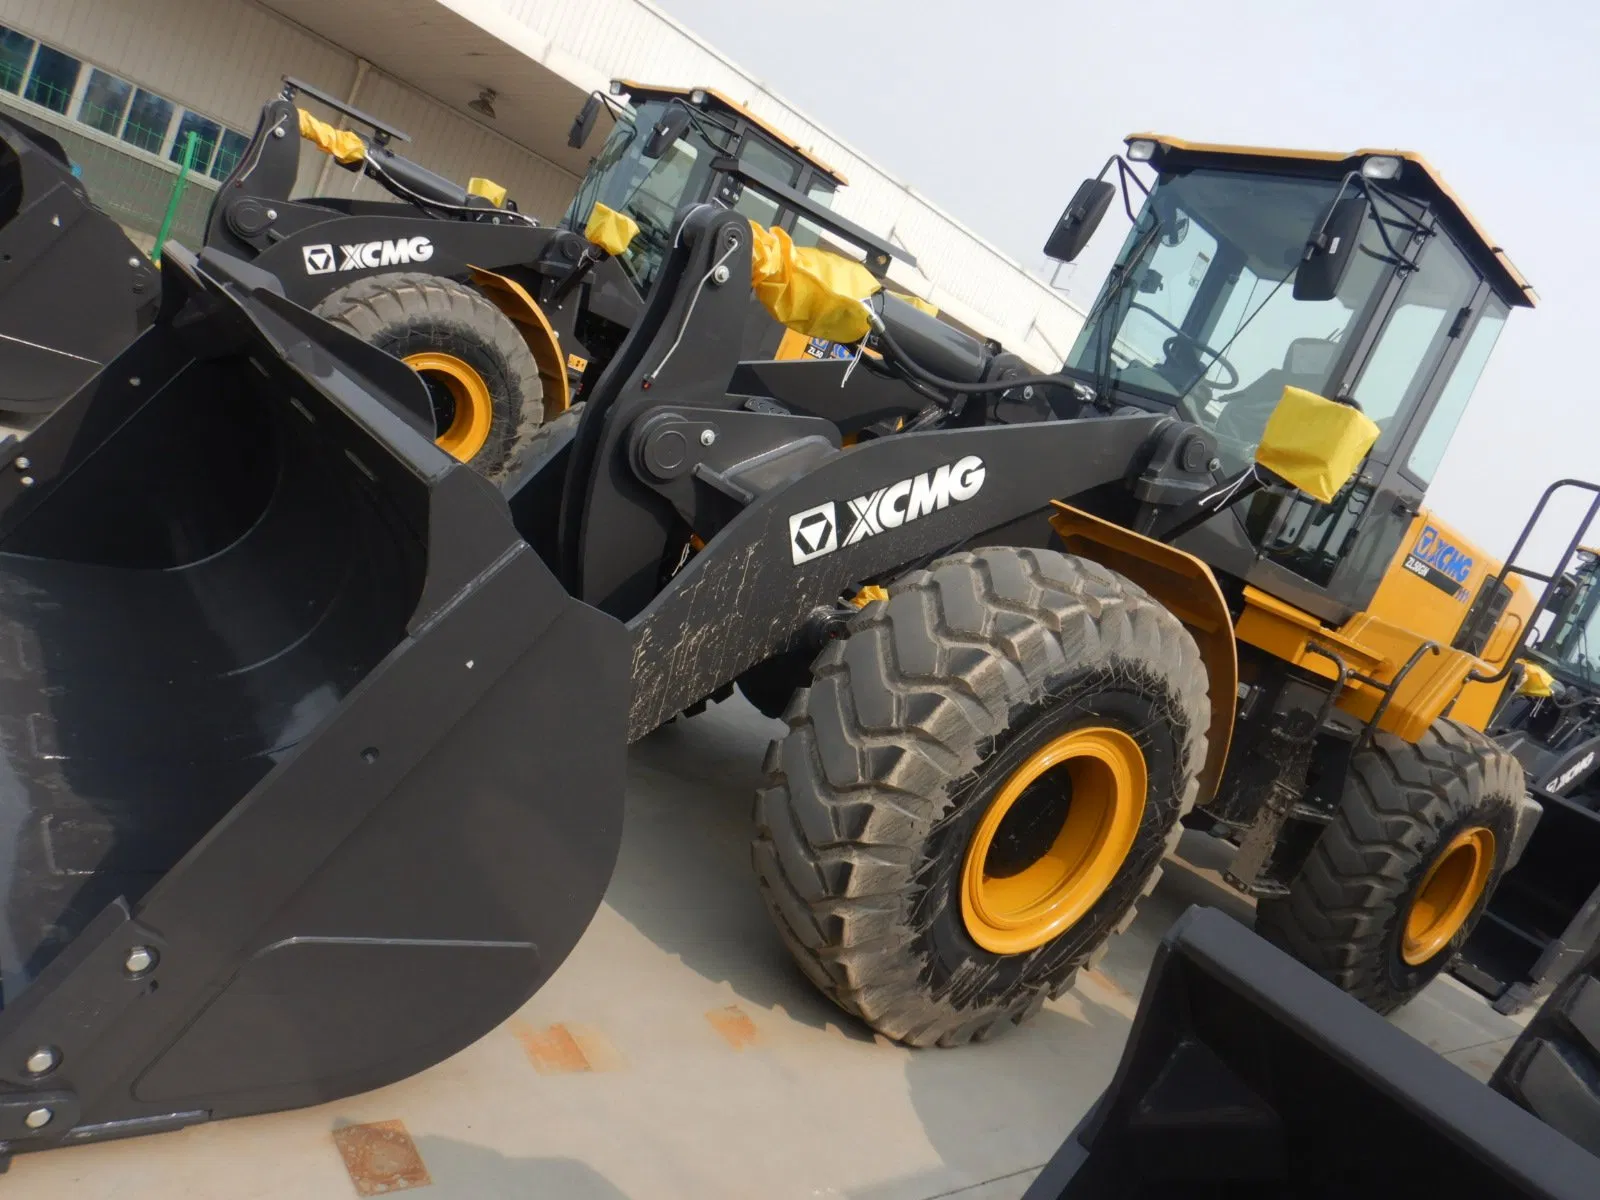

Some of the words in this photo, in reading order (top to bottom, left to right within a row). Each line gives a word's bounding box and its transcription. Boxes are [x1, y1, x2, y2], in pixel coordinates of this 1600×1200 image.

[339, 236, 434, 271] XCMG
[841, 455, 986, 548] XCMG
[1428, 538, 1473, 583] XCMG
